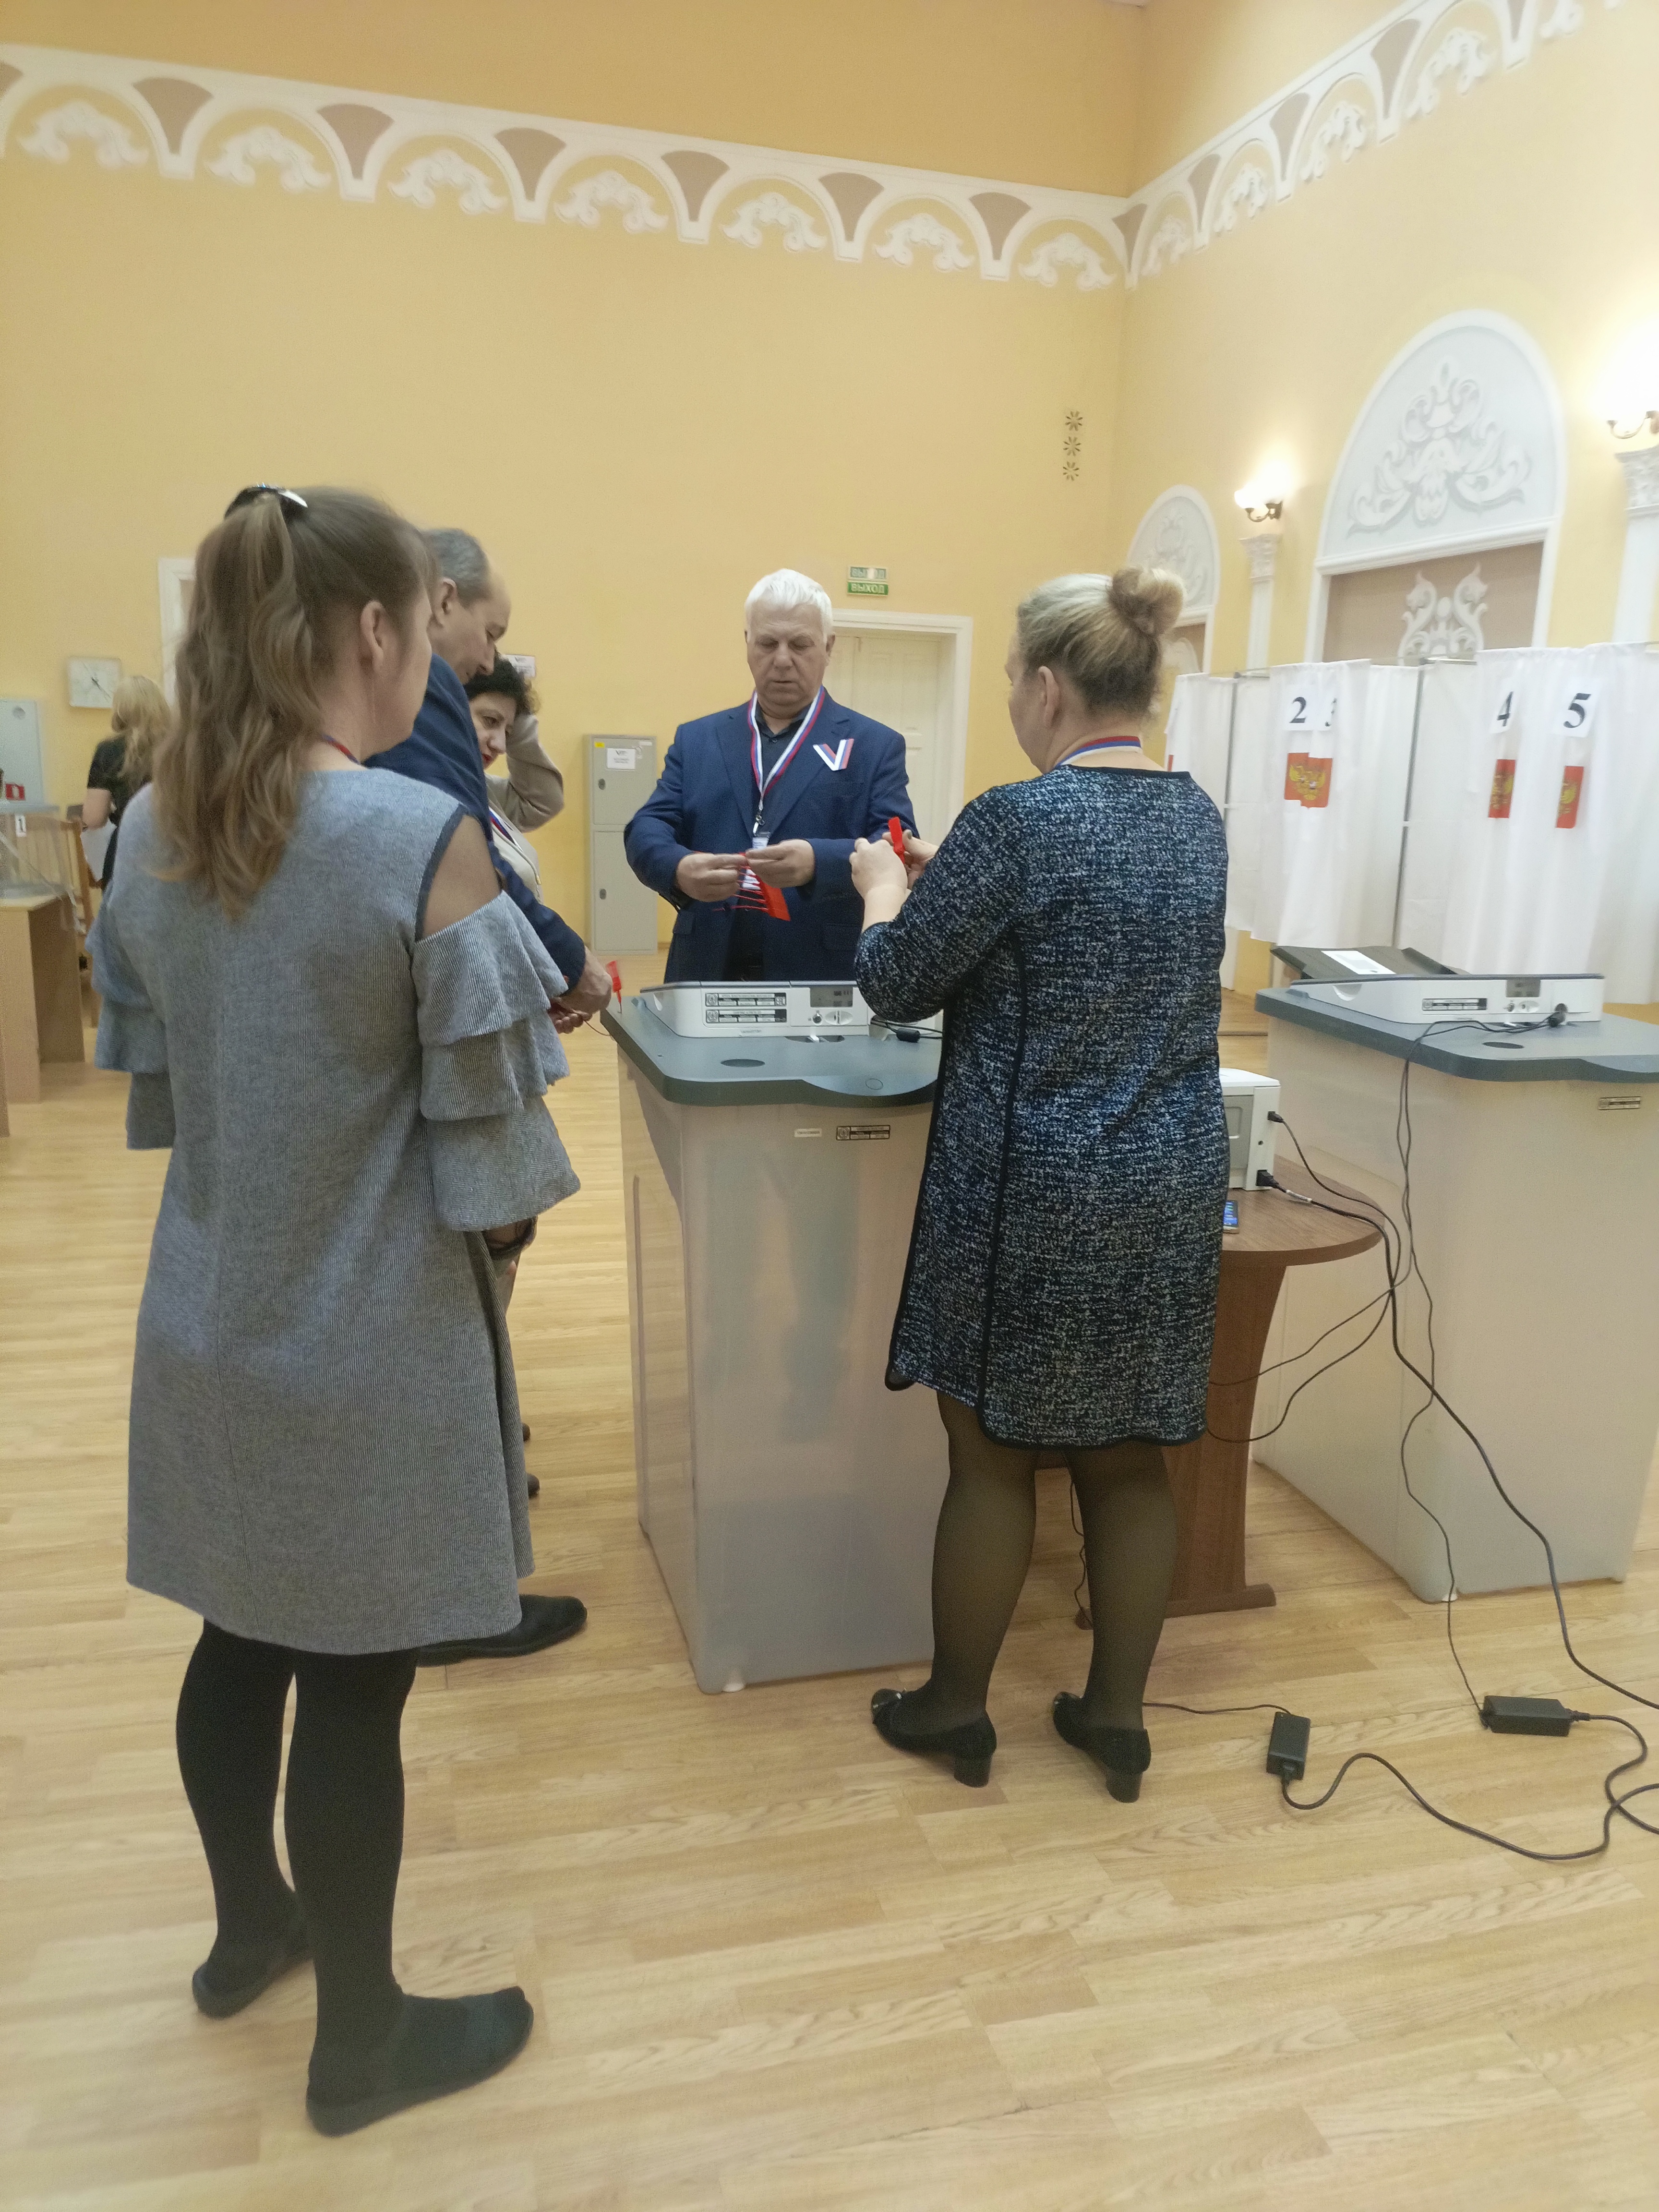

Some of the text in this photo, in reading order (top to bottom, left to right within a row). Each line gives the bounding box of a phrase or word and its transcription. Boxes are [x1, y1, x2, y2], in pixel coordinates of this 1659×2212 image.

[851, 583, 885, 594] ВЫХОД
[1289, 697, 1307, 723] 2
[1497, 691, 1514, 727] 4
[1563, 693, 1591, 728] 5
